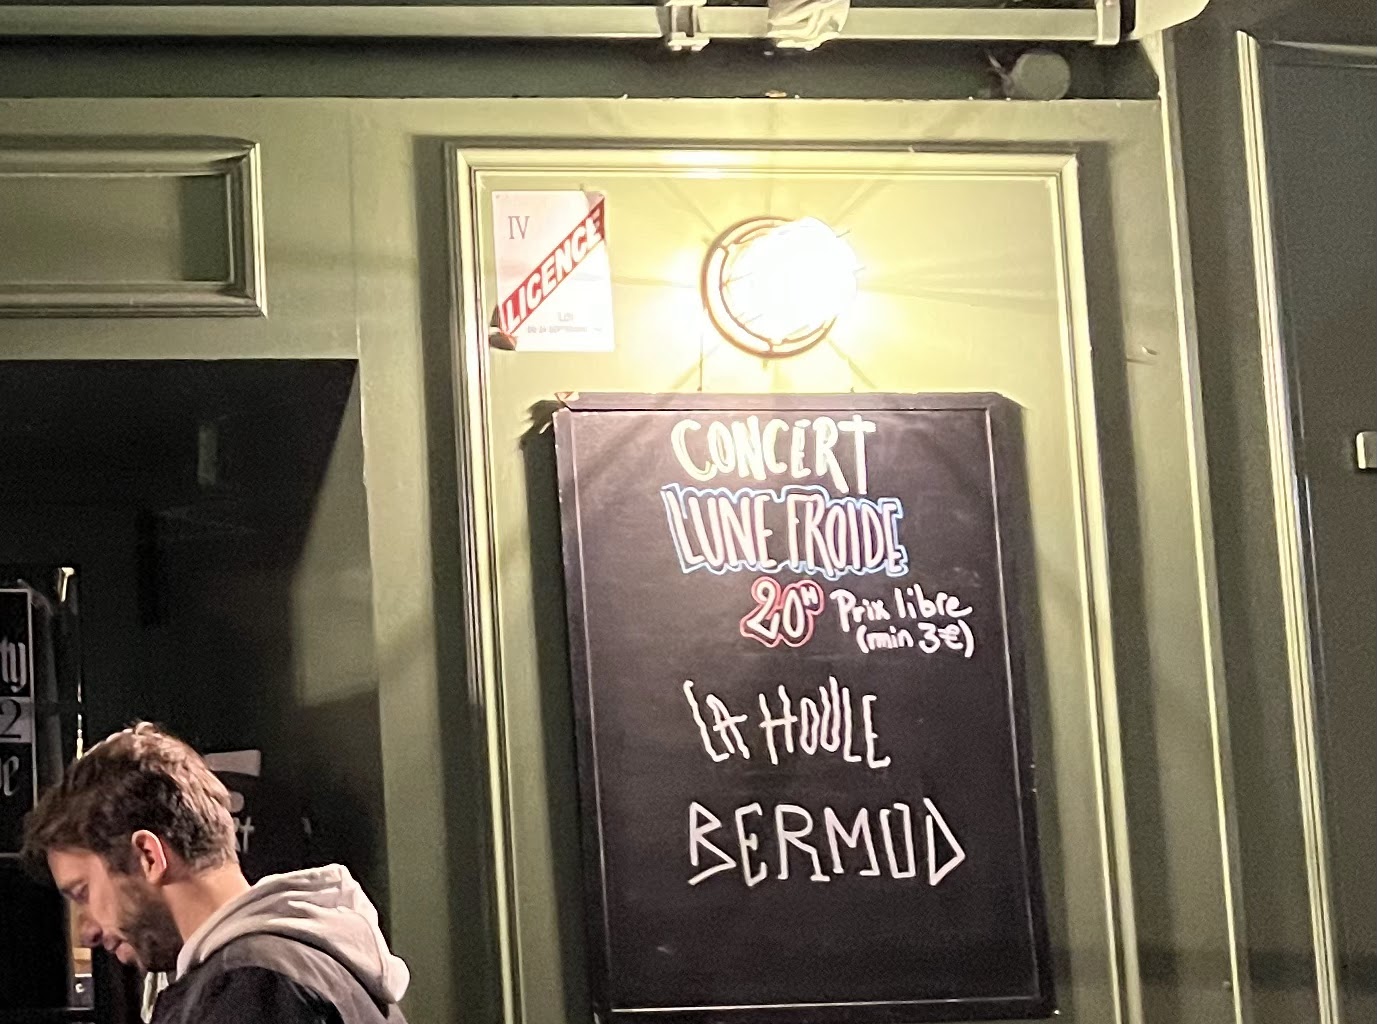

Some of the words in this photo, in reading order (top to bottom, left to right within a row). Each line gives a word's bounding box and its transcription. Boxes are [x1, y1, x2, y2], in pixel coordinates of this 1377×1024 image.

[508, 215, 530, 240] IV
[505, 207, 603, 334] LICENCE
[671, 414, 877, 495] CONCERT
[662, 483, 779, 575] LUNE
[786, 485, 908, 577] FROIDE
[830, 588, 888, 632] Prix
[896, 583, 974, 620] libre
[856, 623, 914, 655] (min
[683, 679, 751, 763] LA
[758, 676, 891, 769] HOULE
